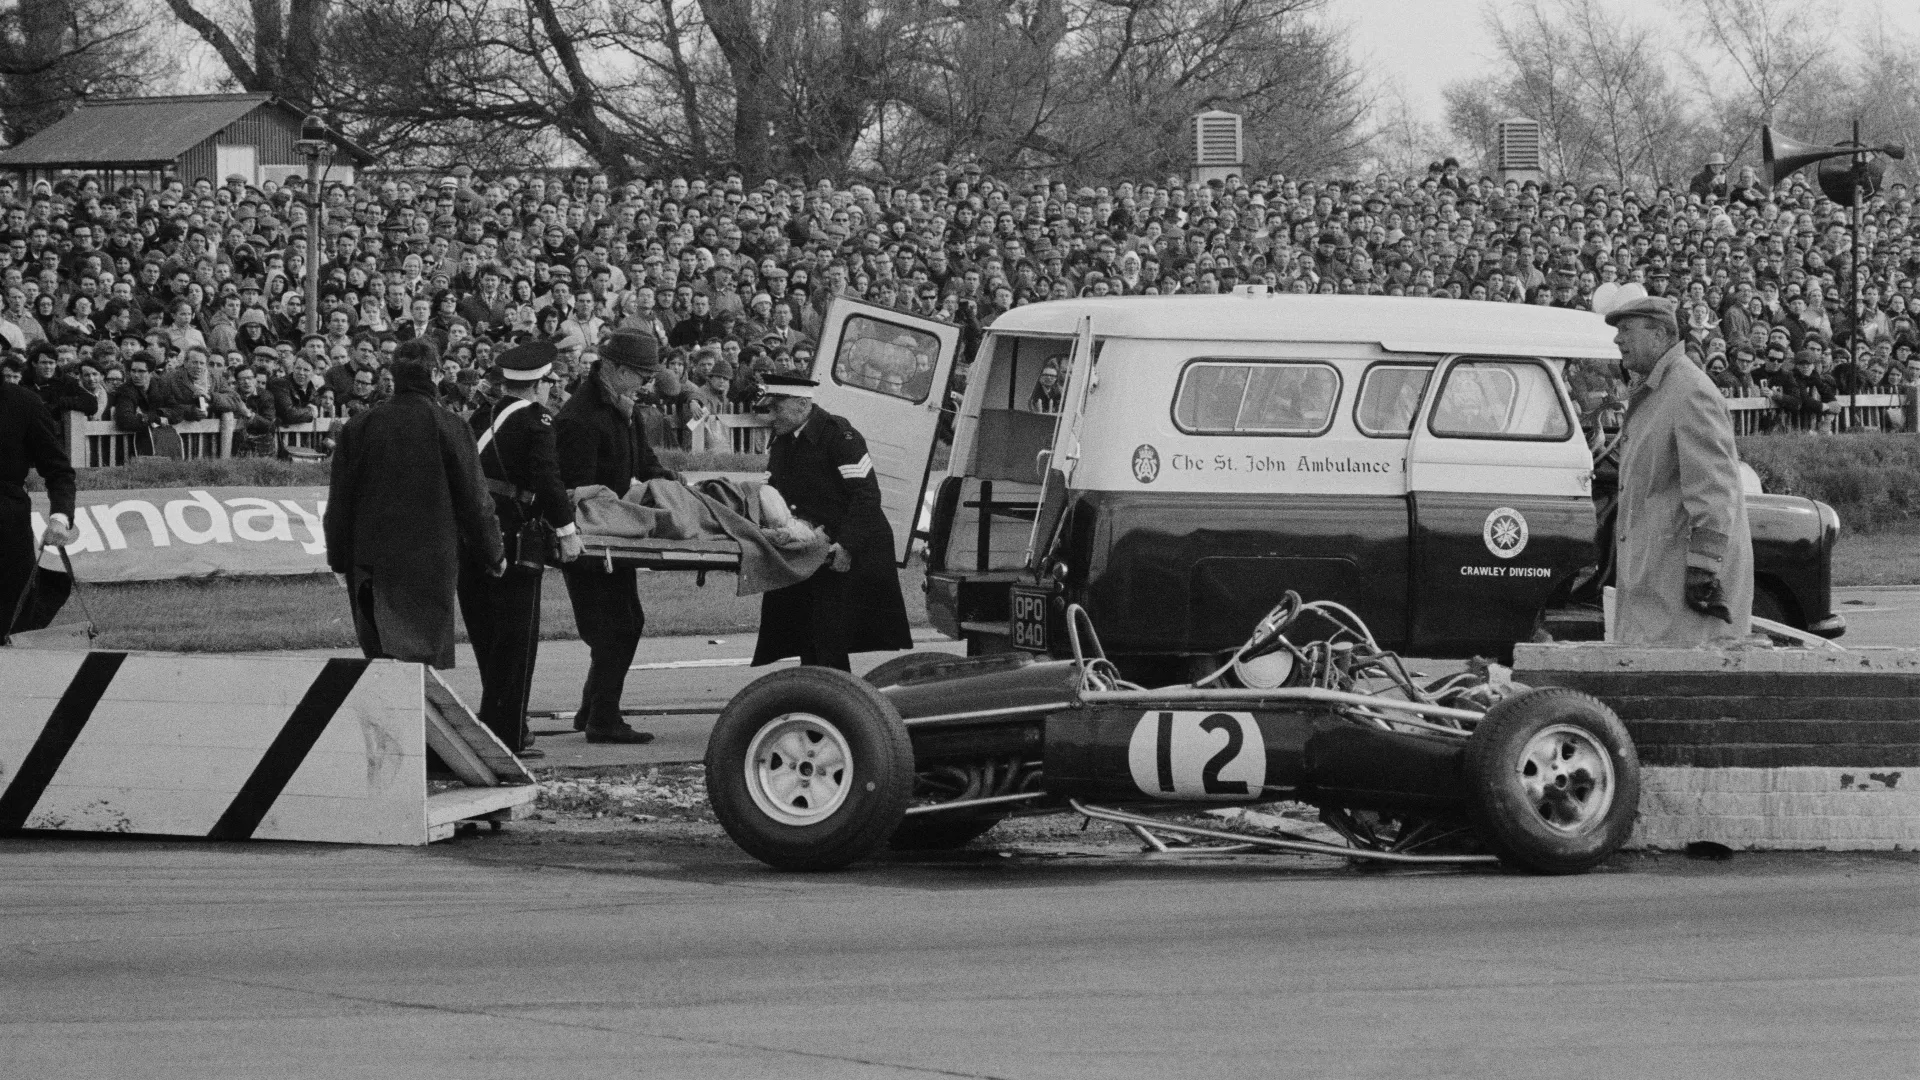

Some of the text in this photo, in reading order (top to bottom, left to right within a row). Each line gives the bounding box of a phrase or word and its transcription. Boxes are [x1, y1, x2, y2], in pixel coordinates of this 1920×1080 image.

[1172, 454, 1204, 470] The
[1214, 455, 1237, 471] St.
[1245, 455, 1286, 473] John
[1297, 455, 1391, 473] Ambulance
[1460, 565, 1551, 578] CRAWLEY DIVISION
[1016, 621, 1043, 646] 840
[1156, 712, 1250, 795] 12
